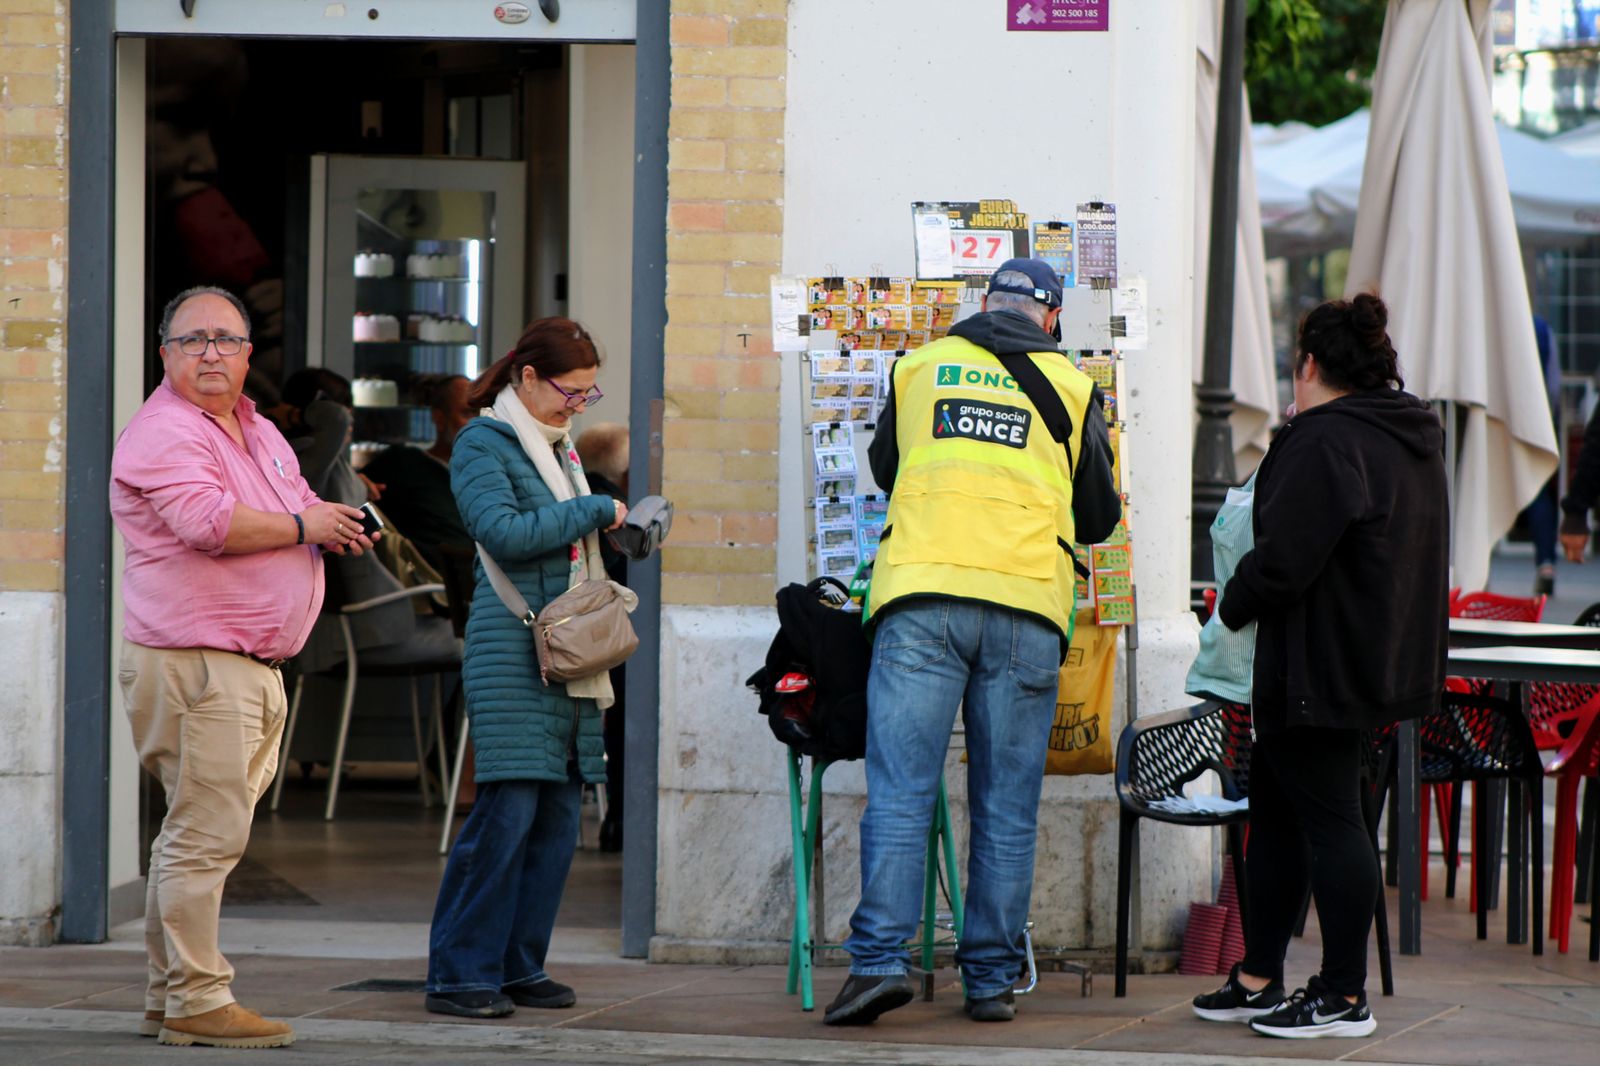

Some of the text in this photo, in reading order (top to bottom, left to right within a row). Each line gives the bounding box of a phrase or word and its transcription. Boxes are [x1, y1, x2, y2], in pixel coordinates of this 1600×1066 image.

[1052, 9, 1098, 17] 902 500 185
[980, 200, 1012, 214] EURO
[950, 219, 965, 228] DE
[969, 213, 1026, 229] JACKPOT
[965, 370, 1024, 392] ONC
[959, 405, 1027, 423] grupo social
[957, 416, 1024, 443] ONCE
